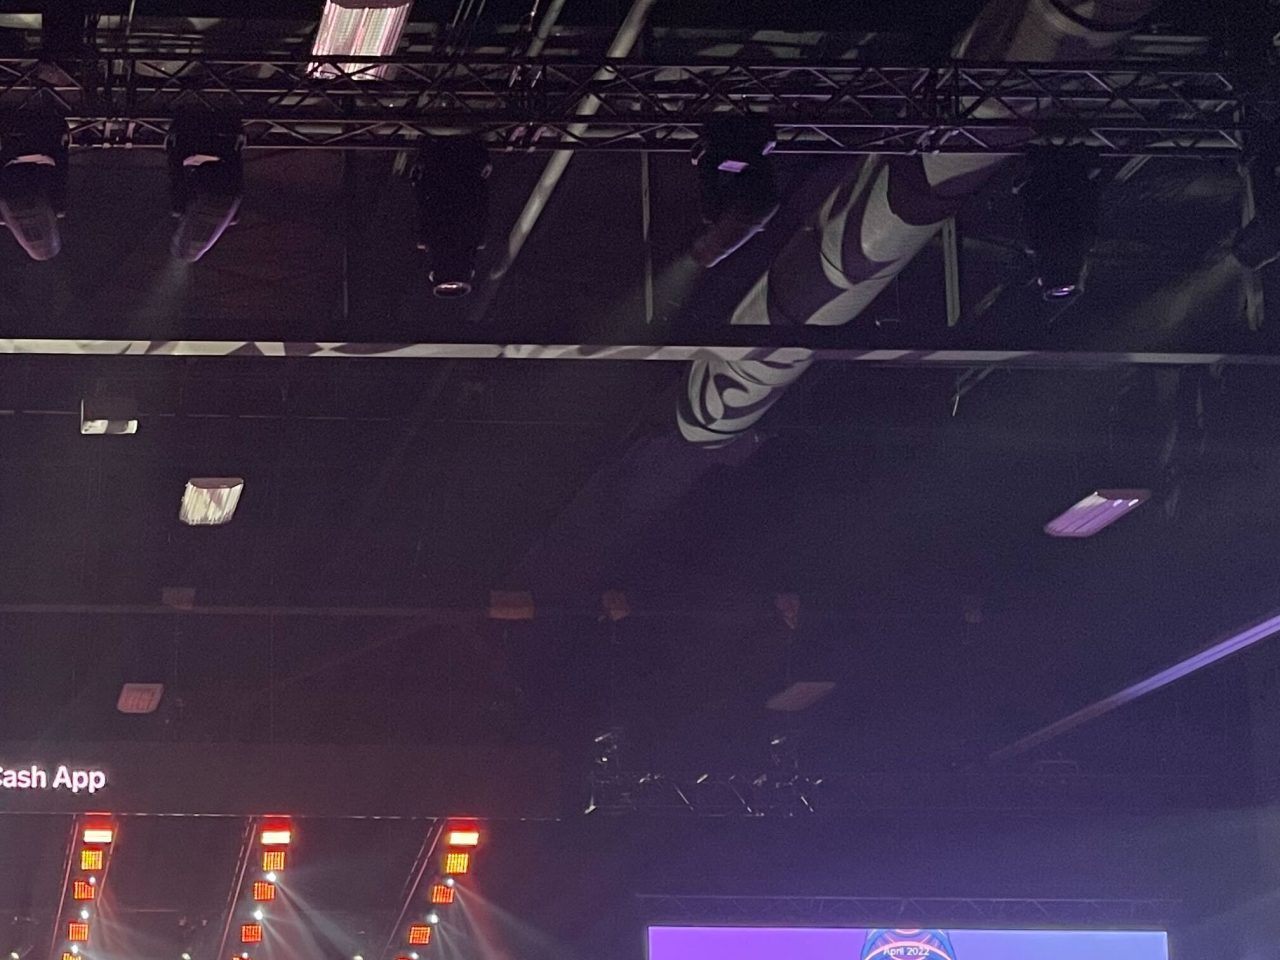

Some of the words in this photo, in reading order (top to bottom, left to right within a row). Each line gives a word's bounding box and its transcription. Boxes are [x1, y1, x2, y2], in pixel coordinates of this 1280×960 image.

[52, 765, 106, 793] App
[883, 946, 905, 957] April
[907, 946, 930, 956] 2022
